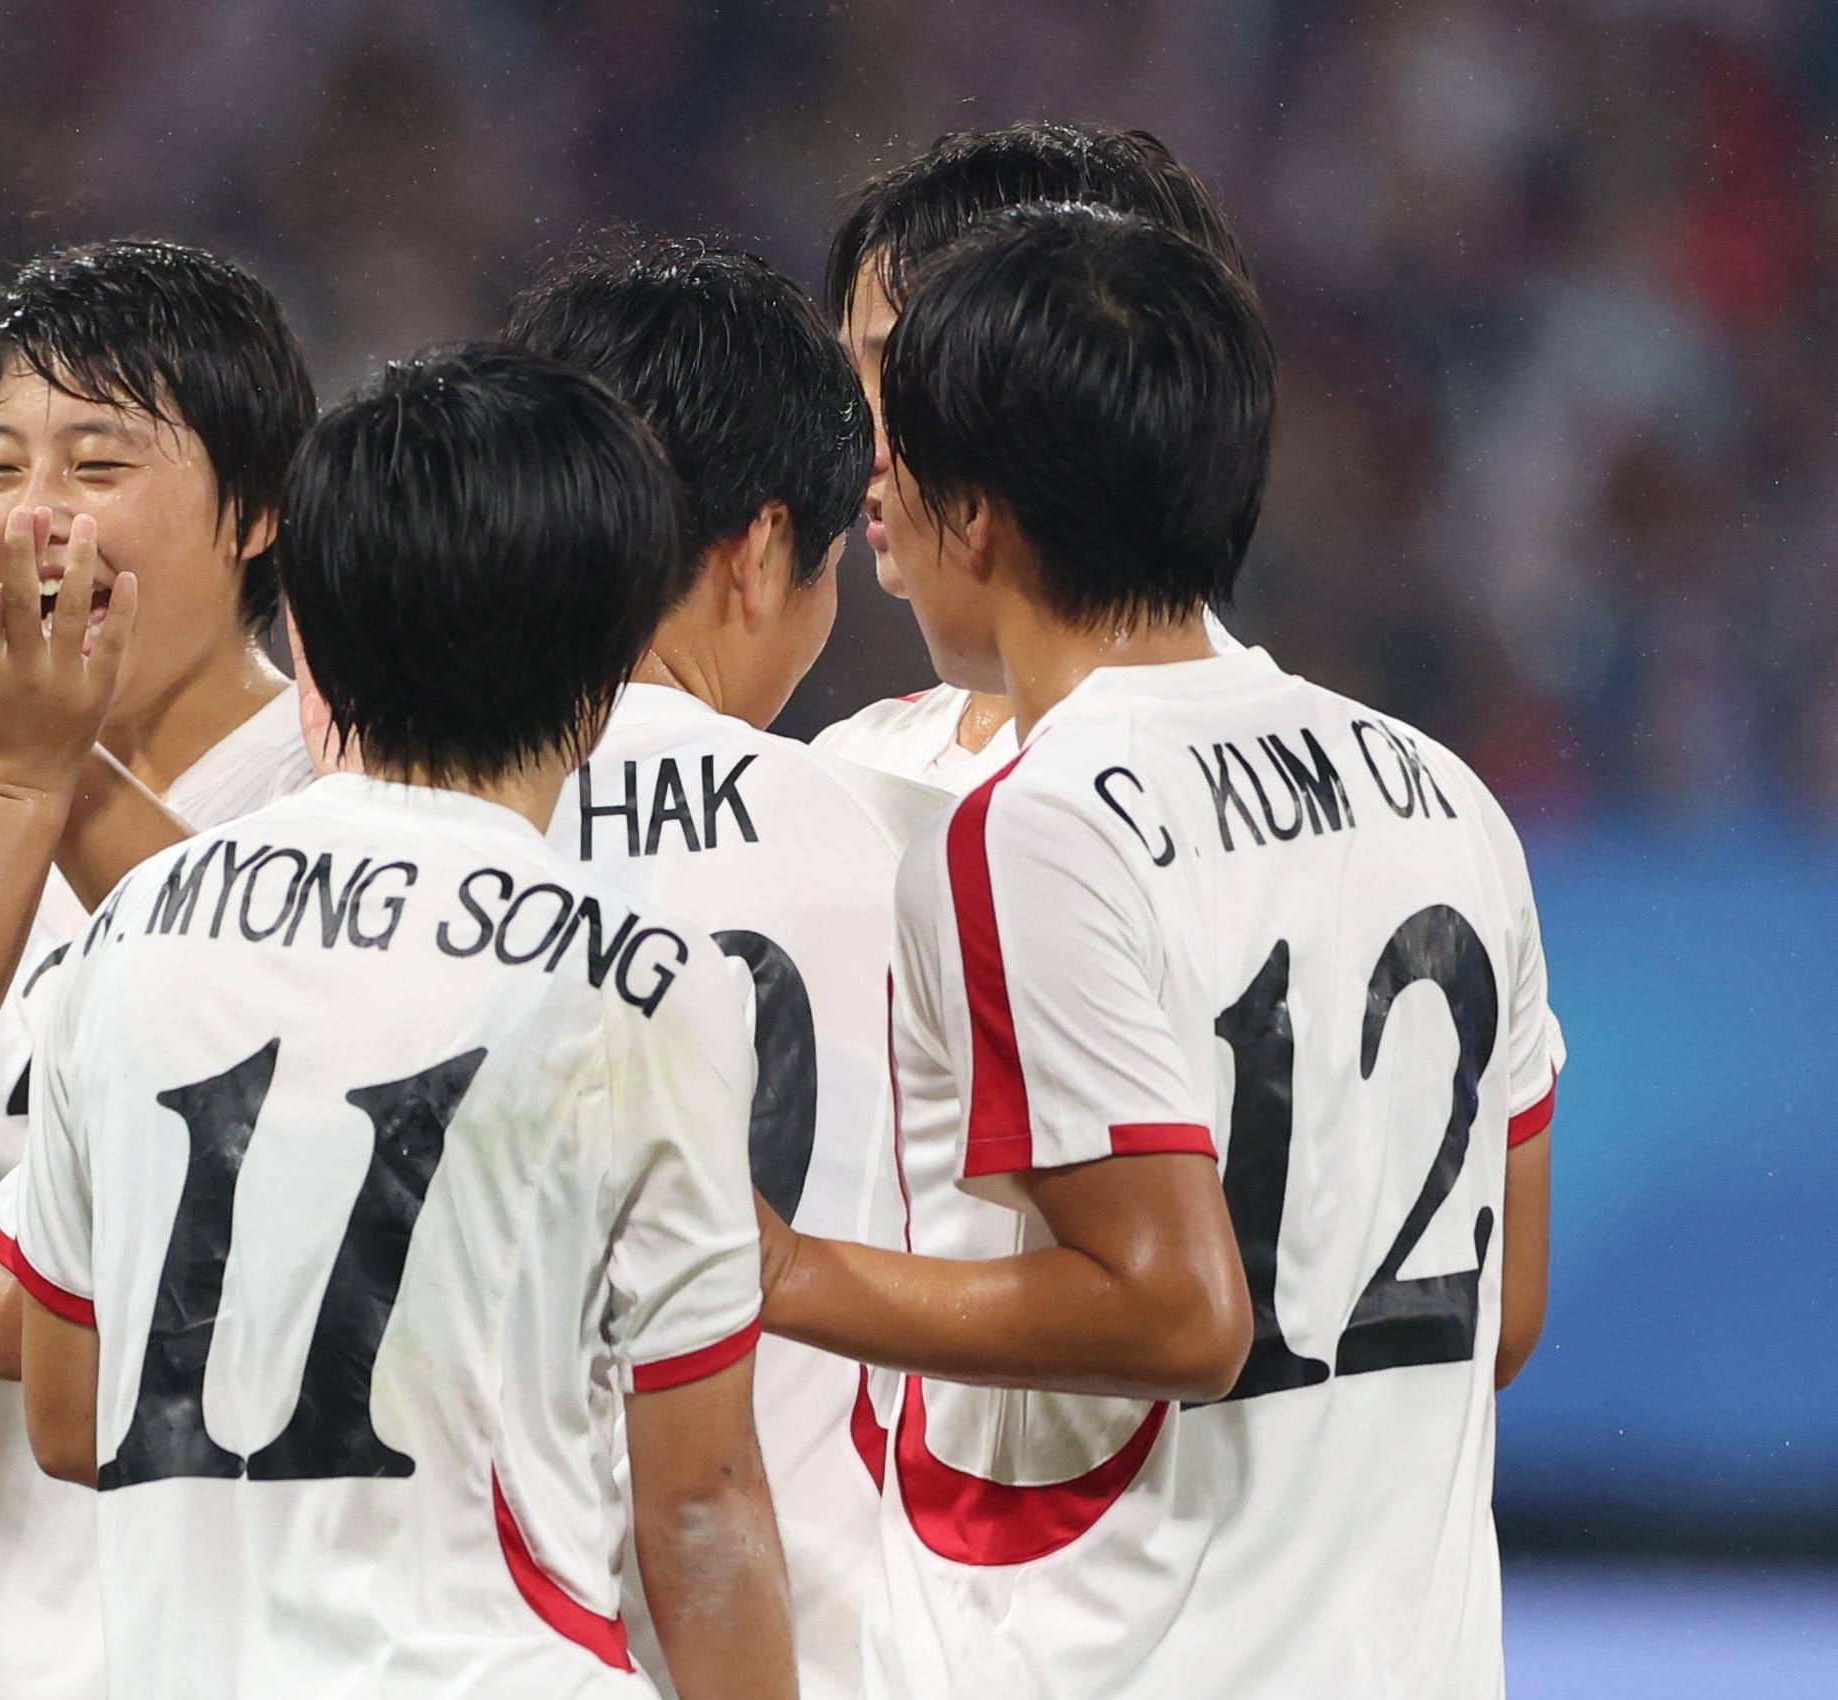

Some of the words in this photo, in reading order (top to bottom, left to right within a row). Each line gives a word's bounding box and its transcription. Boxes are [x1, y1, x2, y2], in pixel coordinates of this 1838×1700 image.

[578, 754, 759, 861] HAK
[1187, 727, 1357, 853] KUM
[146, 840, 417, 950] MYONG
[436, 867, 689, 1019] SONG
[1180, 903, 1499, 1411] 12
[97, 1036, 489, 1492] 11
